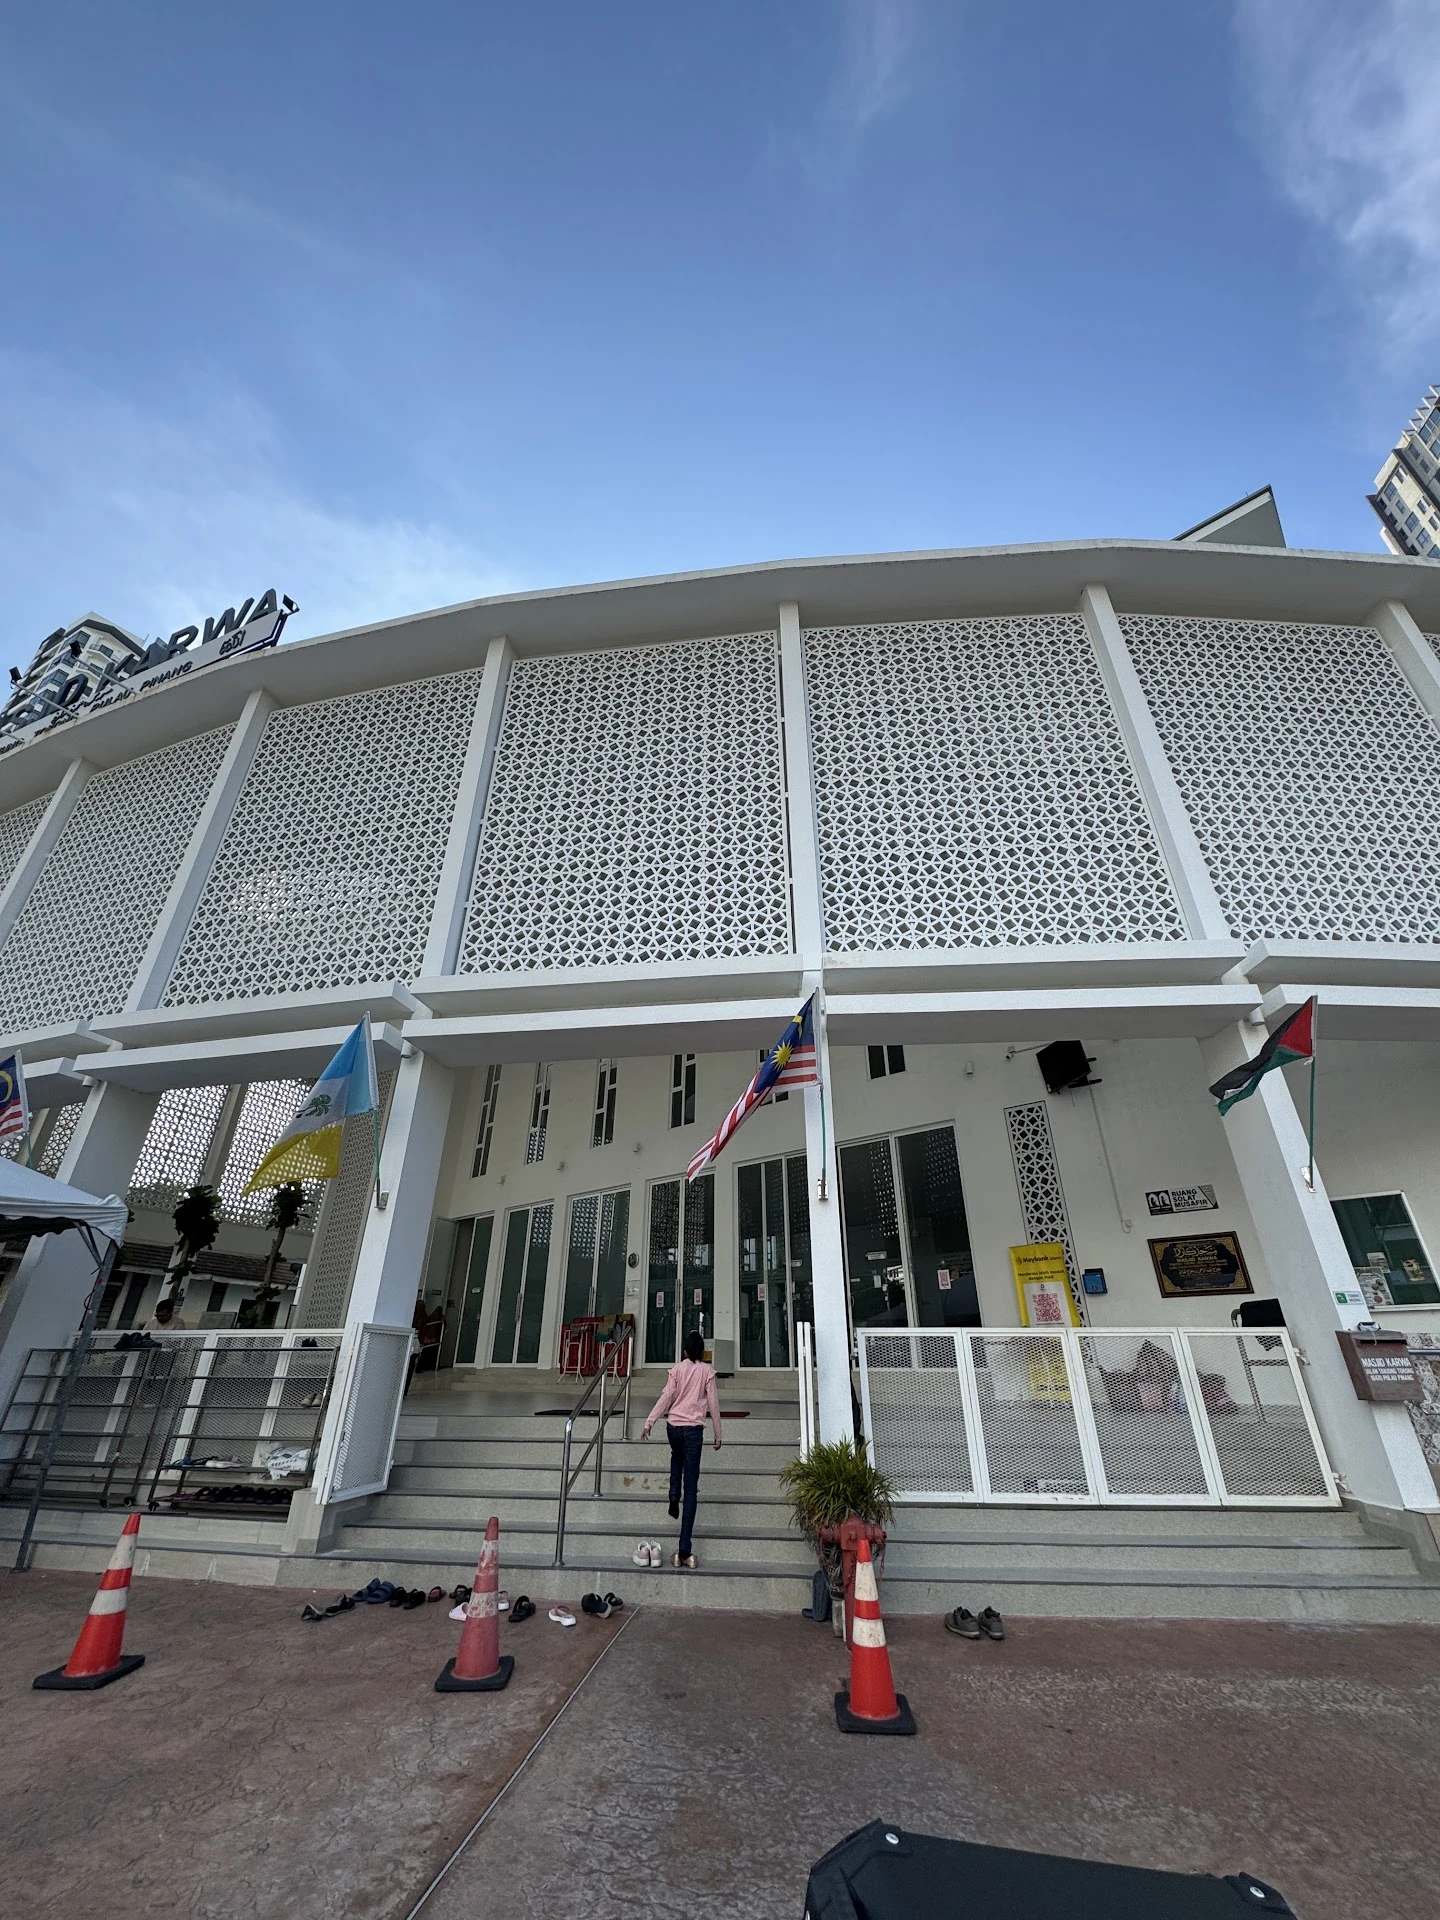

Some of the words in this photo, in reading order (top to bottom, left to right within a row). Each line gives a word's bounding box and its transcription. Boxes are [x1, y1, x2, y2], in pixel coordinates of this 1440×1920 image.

[96, 588, 278, 693] KARWA
[89, 687, 134, 713] PULAU
[139, 661, 193, 692] PINANG
[1171, 1189, 1197, 1197] RUANG
[1175, 1199, 1208, 1208] MUSAFIR
[1022, 1255, 1049, 1263] Maybank
[1360, 1357, 1386, 1367] MASJID
[1385, 1357, 1412, 1367] KARWA
